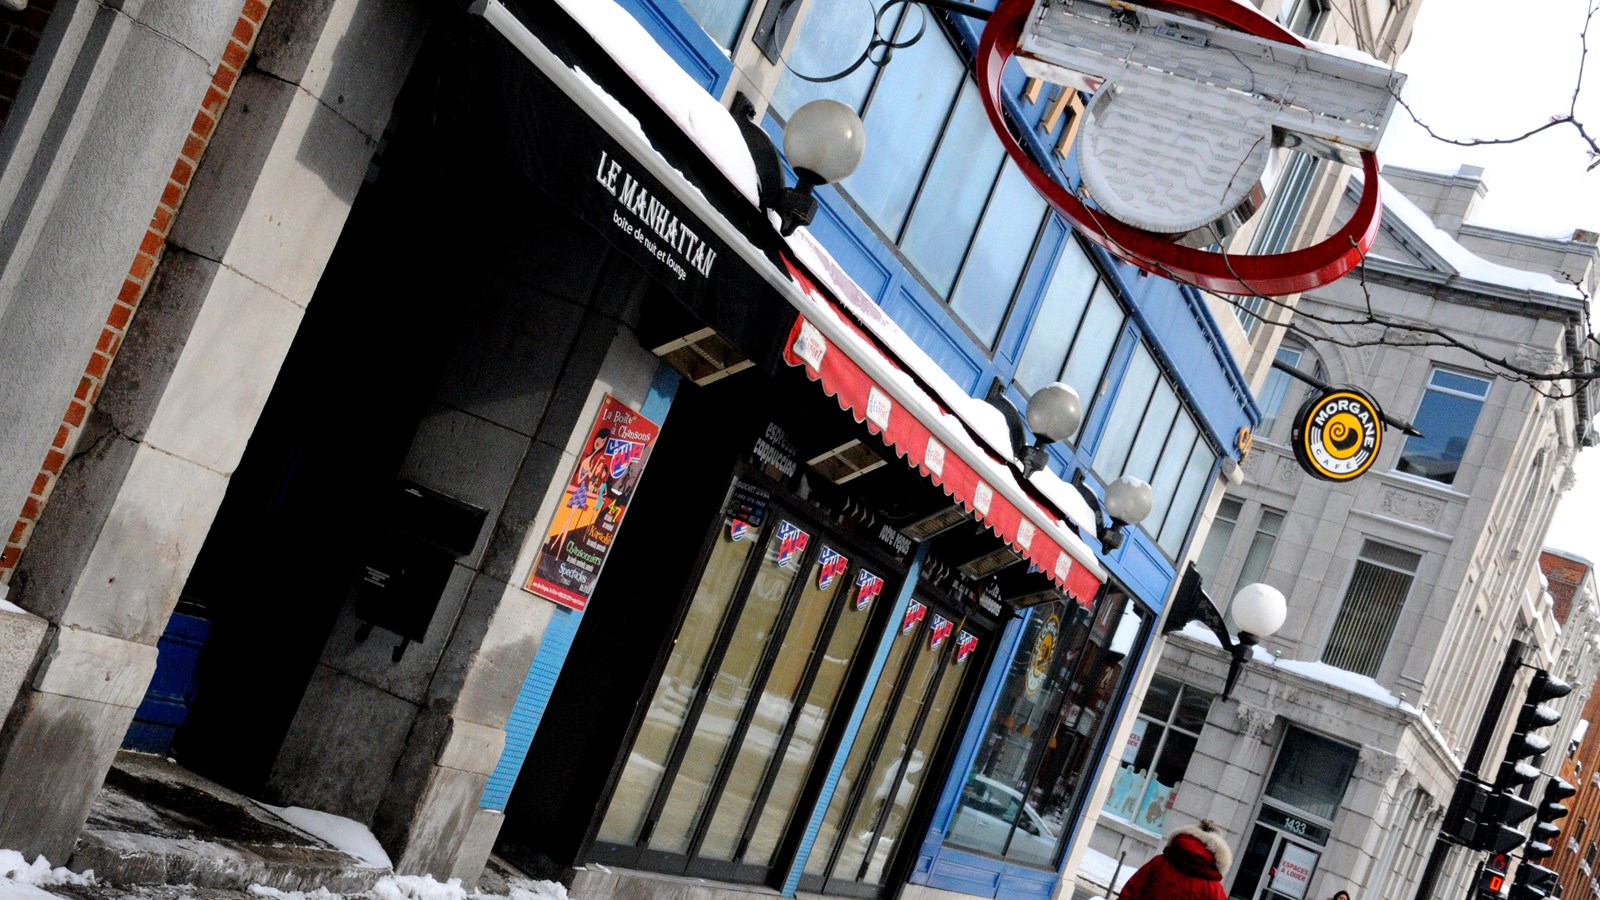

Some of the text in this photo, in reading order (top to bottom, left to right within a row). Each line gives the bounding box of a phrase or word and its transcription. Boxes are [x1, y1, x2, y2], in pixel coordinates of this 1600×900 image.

[596, 150, 717, 279] LE MANHATTAN
[634, 228, 644, 243] de
[644, 238, 657, 256] nuit
[657, 250, 666, 262] et
[666, 254, 687, 281] lounge
[603, 408, 612, 421] La
[618, 425, 651, 441] Chansons
[1315, 400, 1375, 448] MORGANE
[610, 440, 619, 450] LE
[1315, 448, 1353, 470] CAFÉ
[559, 563, 587, 583] Spectacles
[1285, 817, 1307, 835] 1433
[1282, 861, 1309, 876] ESPACES
[1286, 869, 1307, 882] LOUER
